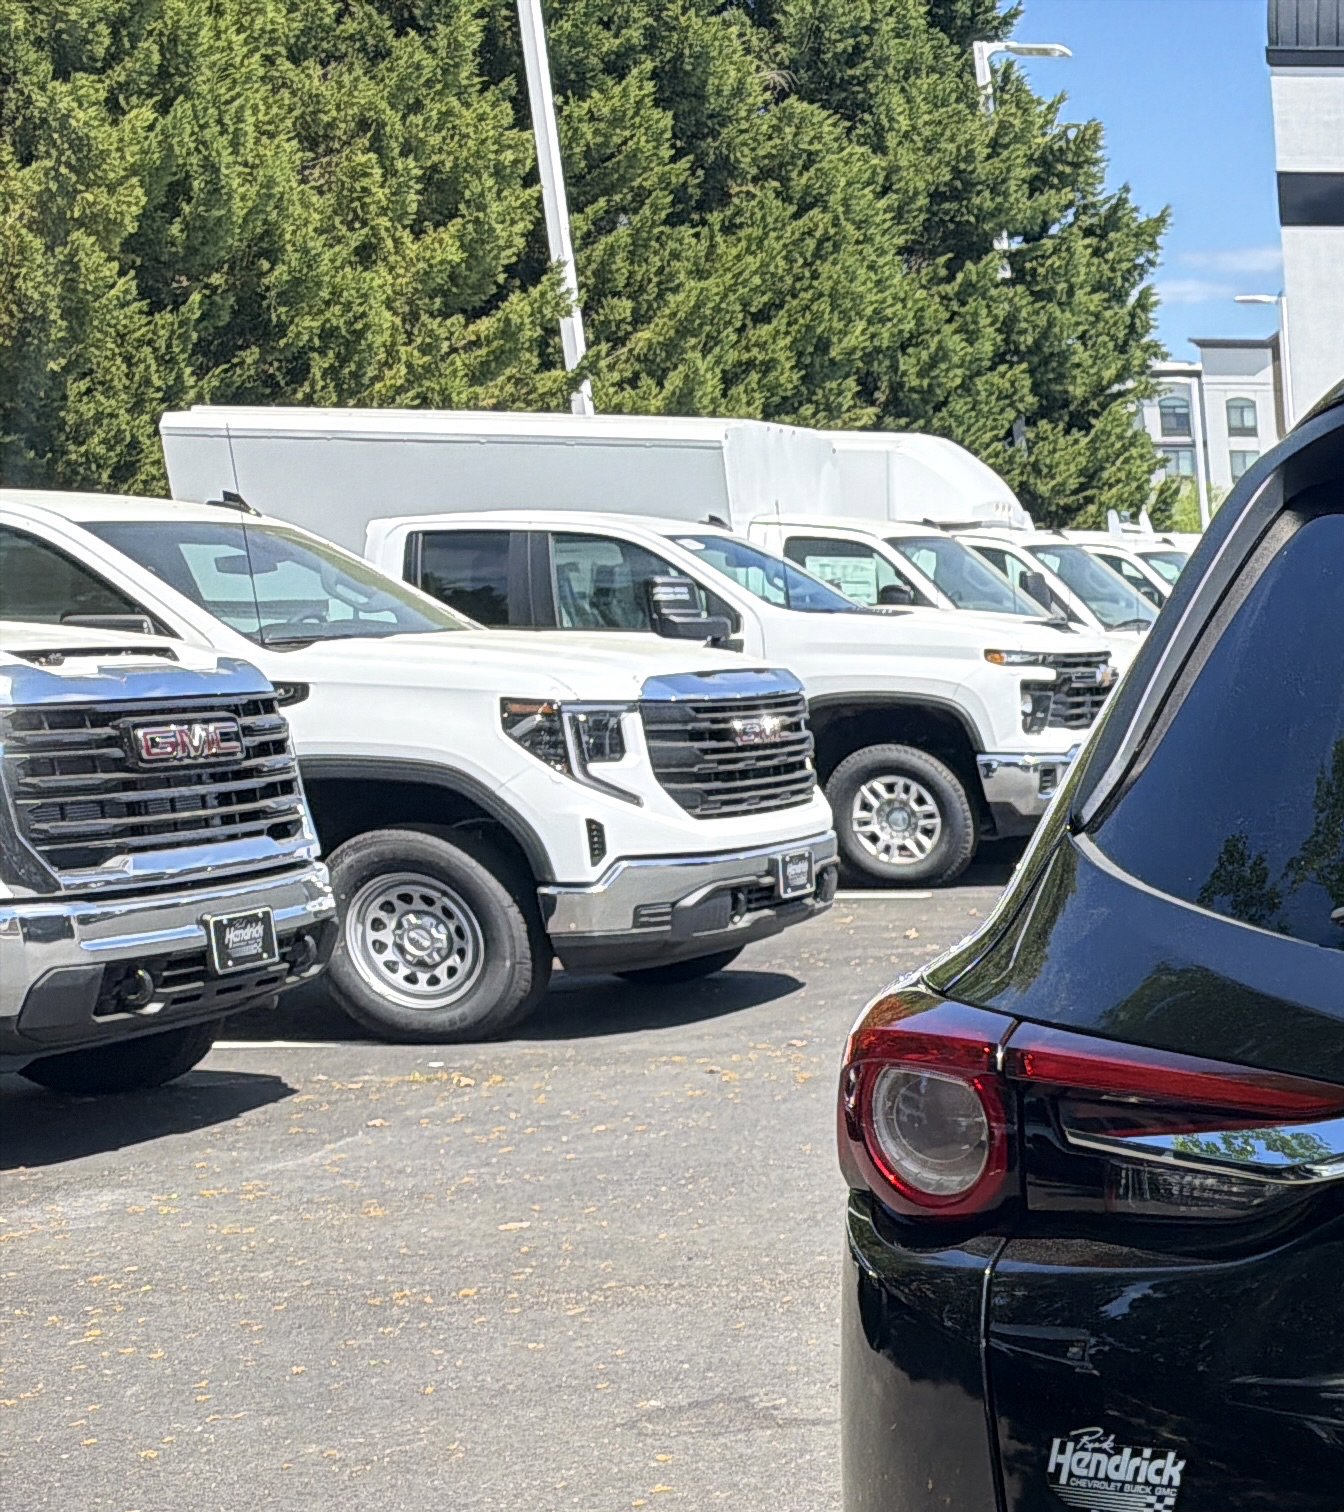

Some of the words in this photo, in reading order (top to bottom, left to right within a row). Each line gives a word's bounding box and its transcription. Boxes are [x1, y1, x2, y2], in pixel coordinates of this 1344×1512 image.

[135, 721, 241, 760] GMC
[1047, 1438, 1187, 1485] Hendrick
[1069, 1478, 1121, 1492] CHEVROLET
[1124, 1483, 1152, 1494] BUICK
[1155, 1487, 1178, 1497] GMC
